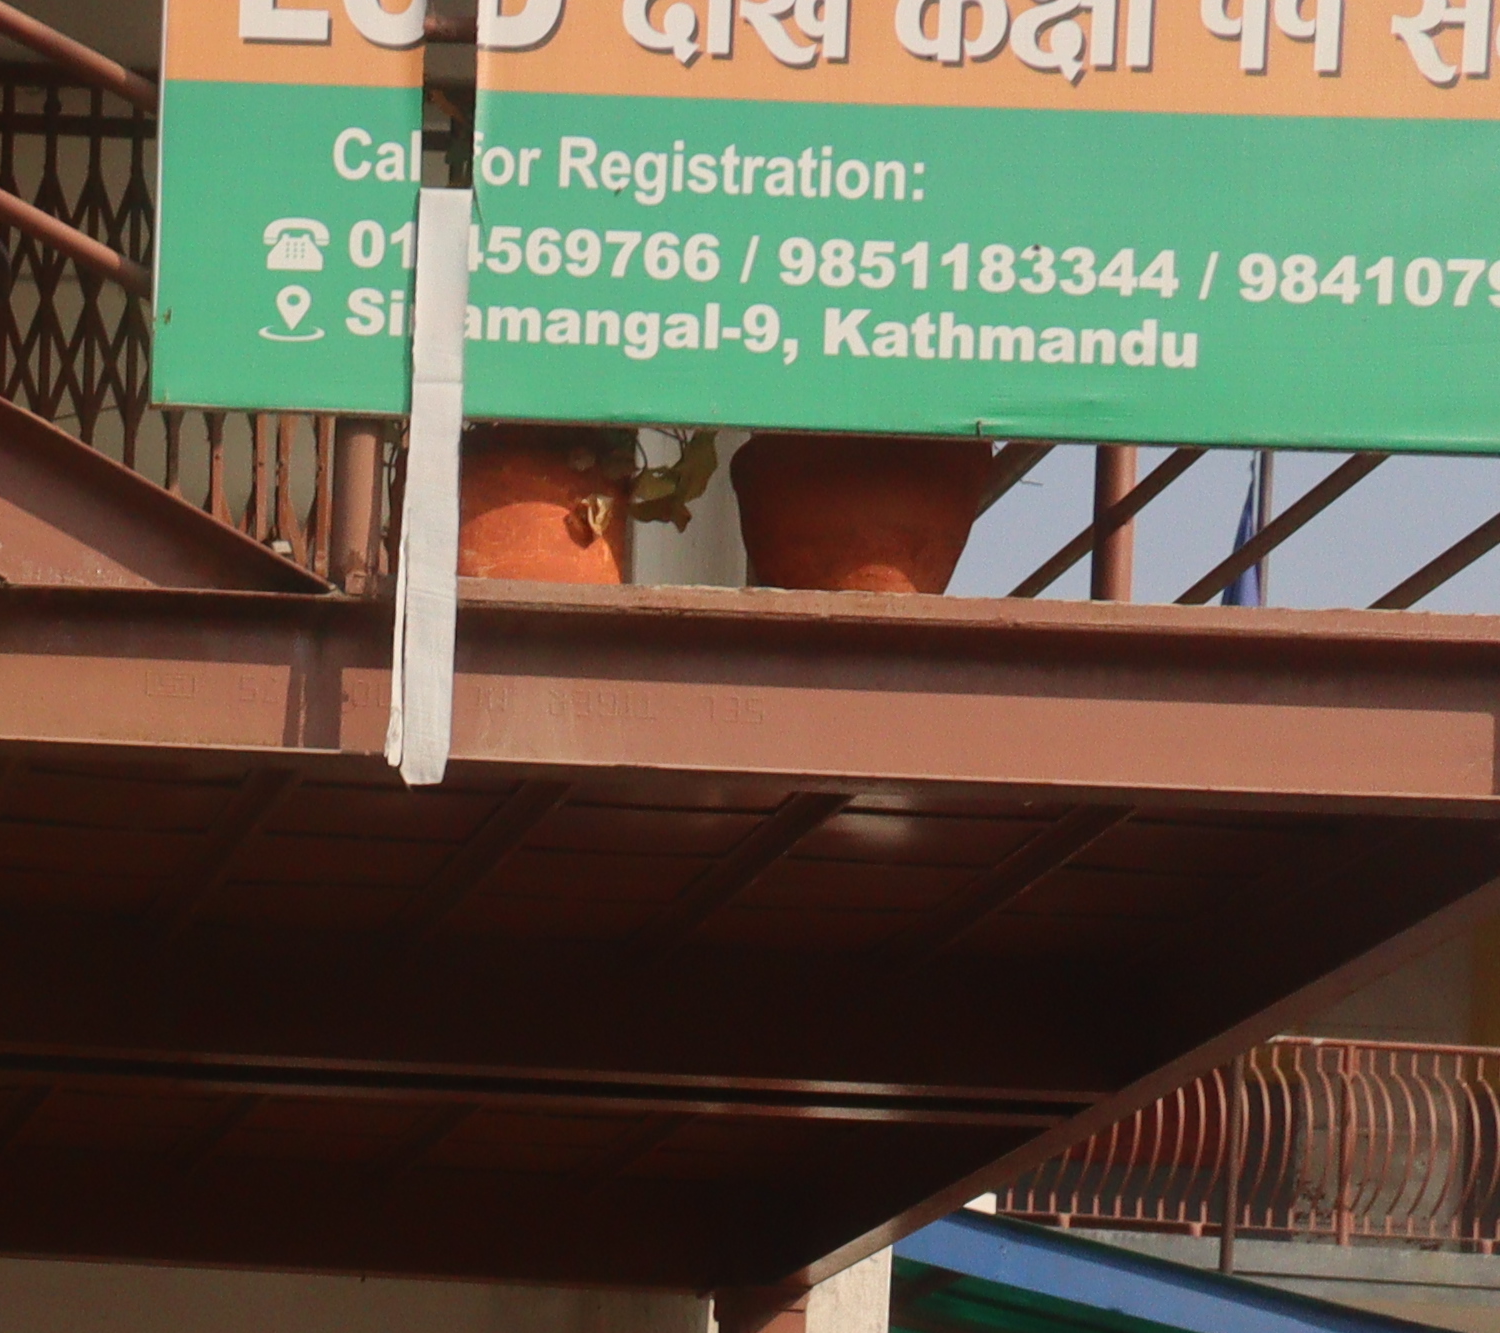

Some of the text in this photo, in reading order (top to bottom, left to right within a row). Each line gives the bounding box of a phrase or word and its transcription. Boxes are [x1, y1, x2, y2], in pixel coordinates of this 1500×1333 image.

[332, 126, 926, 206] Cal or Registration:
[348, 219, 721, 283] 01569766
[739, 235, 761, 284] /
[778, 237, 1180, 299] 9851183344
[1198, 250, 1220, 300] /
[345, 287, 1199, 369] Siamangal-9, Kathmandu
